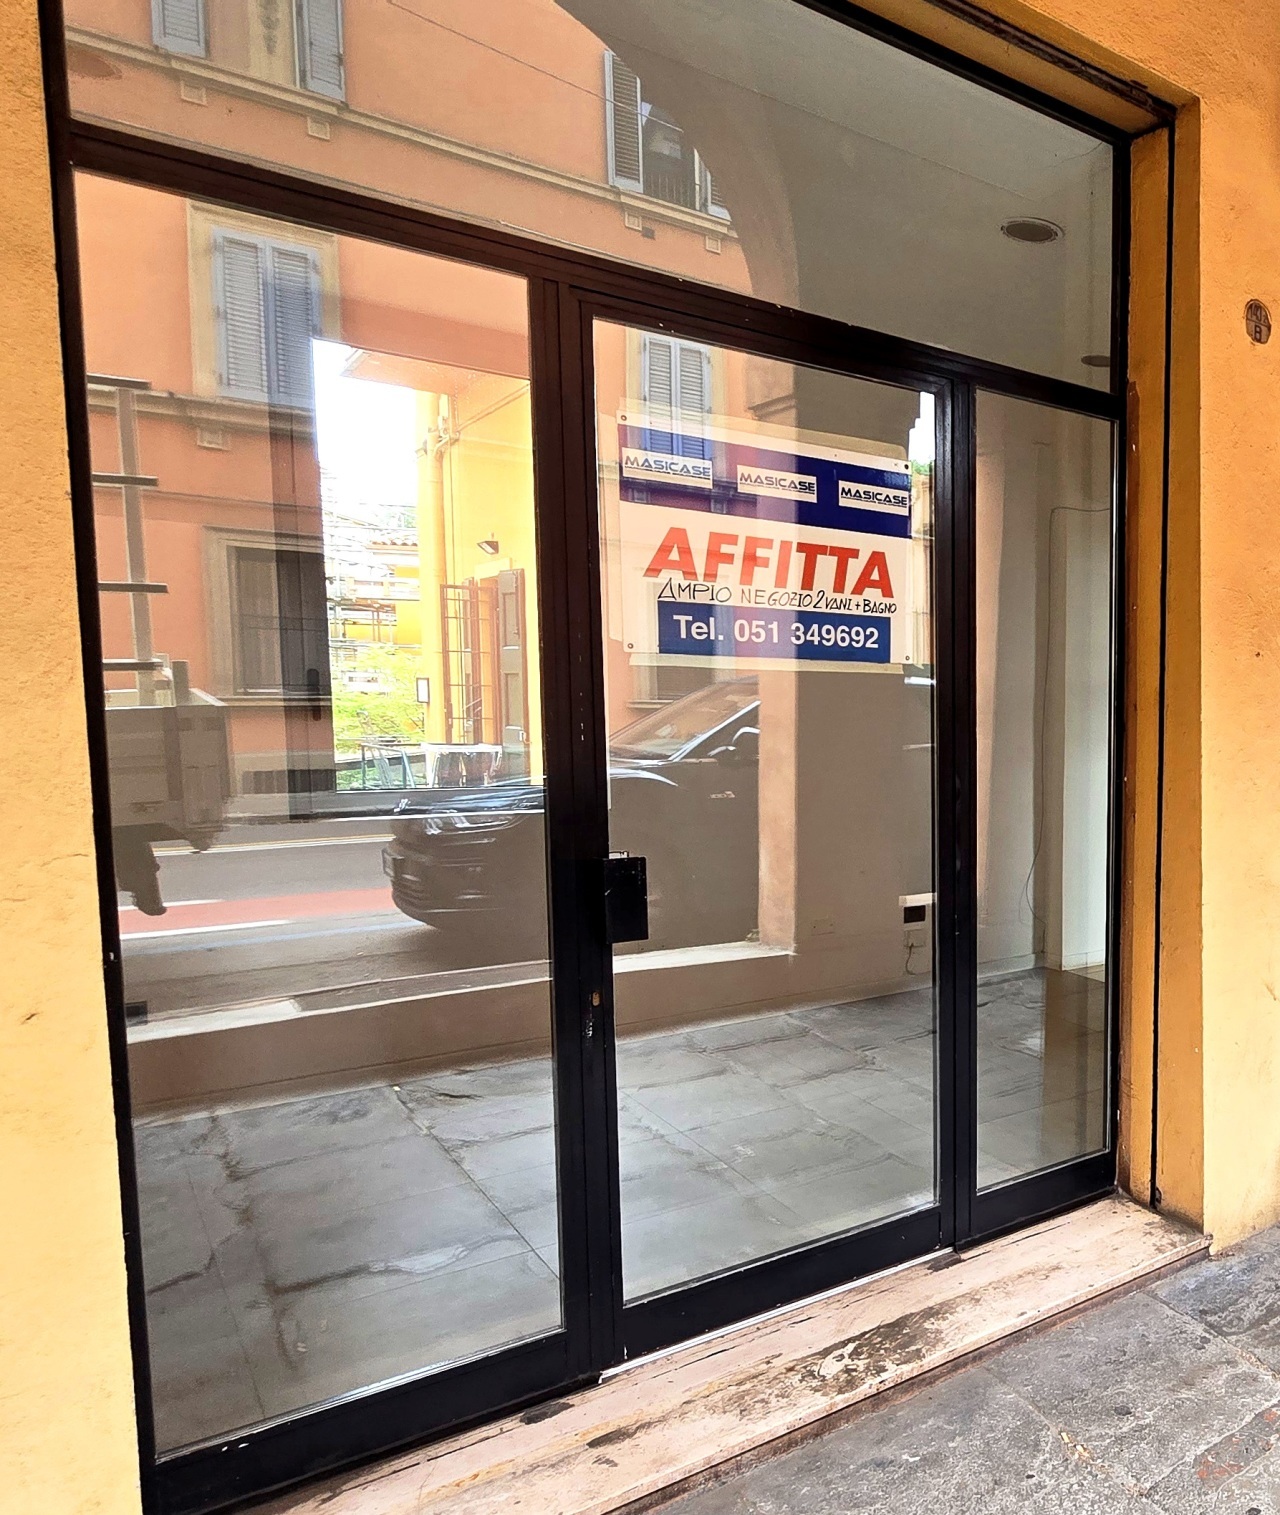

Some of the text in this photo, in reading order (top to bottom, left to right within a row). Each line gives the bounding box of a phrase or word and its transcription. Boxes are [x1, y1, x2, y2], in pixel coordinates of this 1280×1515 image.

[625, 455, 711, 477] MASICASE
[740, 472, 815, 492] MASICASE
[841, 487, 907, 505] MASICASE
[643, 526, 894, 598] AFFITTA
[657, 577, 732, 603] AMPIO
[741, 588, 813, 608] NEGOZIO
[862, 598, 897, 614] BAGNO
[673, 614, 879, 649] Tel. 051 349692
